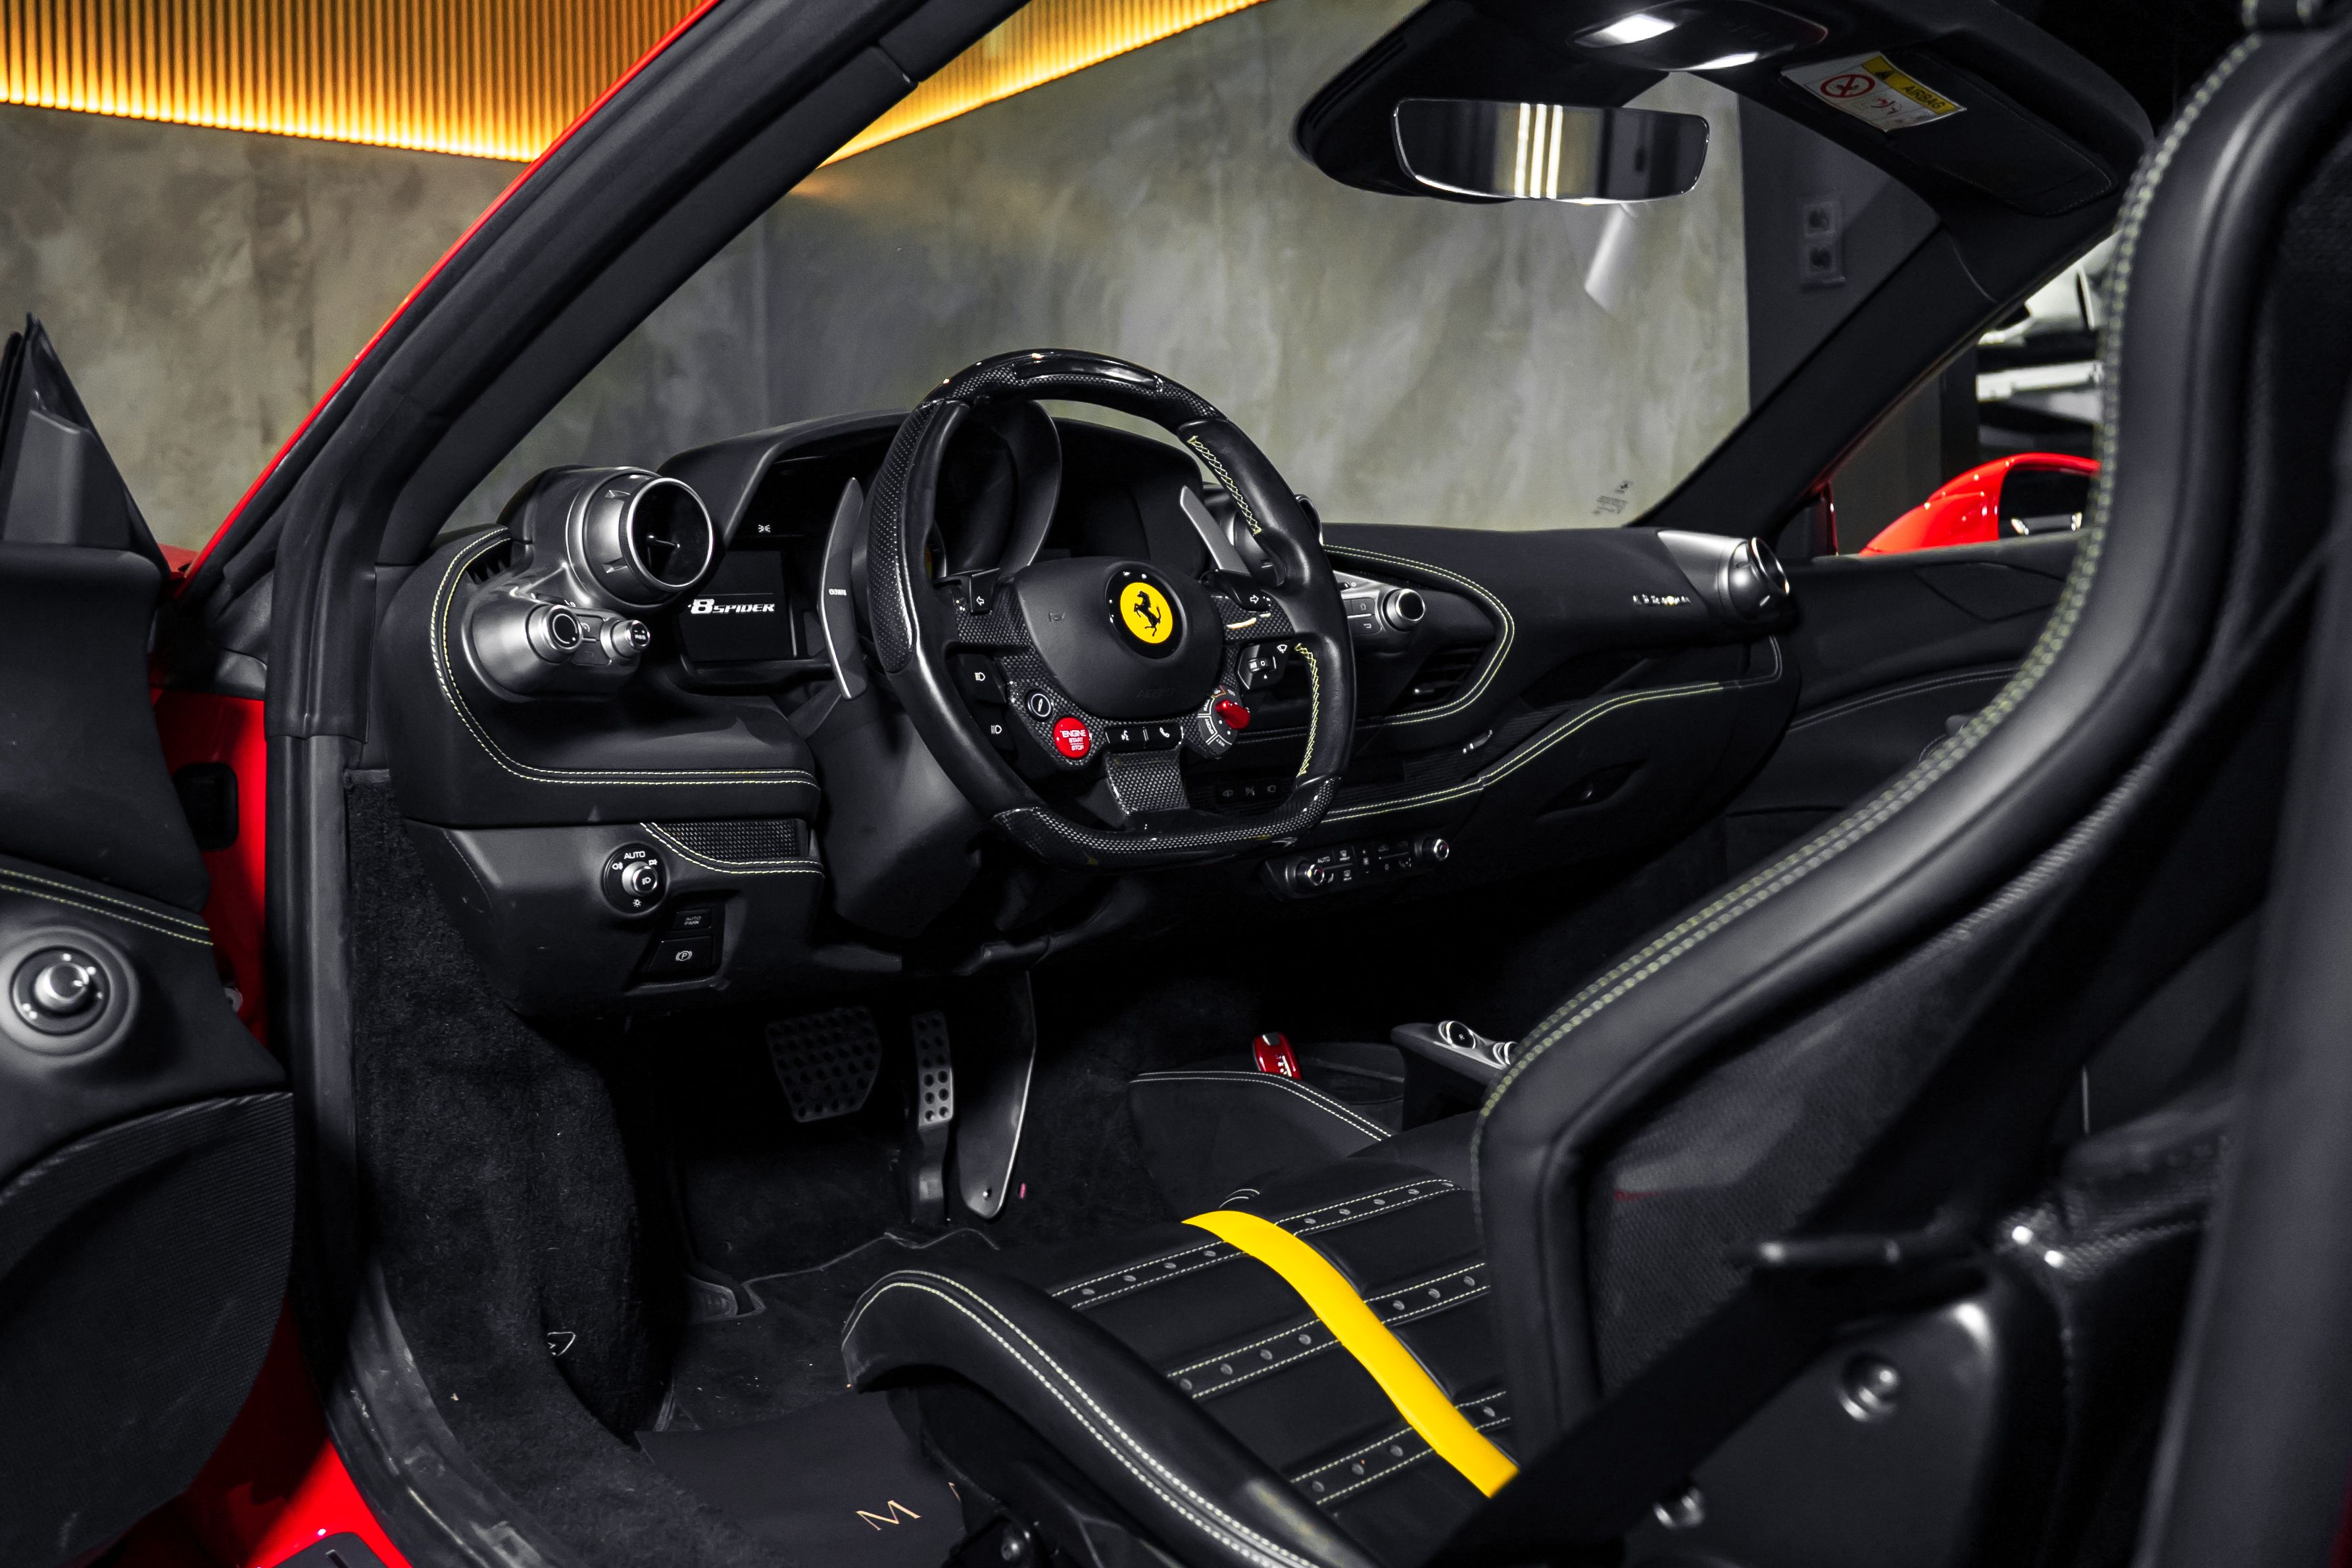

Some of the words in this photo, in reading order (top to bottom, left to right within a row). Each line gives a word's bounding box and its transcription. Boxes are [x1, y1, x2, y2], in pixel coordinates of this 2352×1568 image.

[1903, 85, 1946, 109] AIRBAG
[713, 603, 775, 613] SPIDER
[1062, 729, 1087, 738] ENGINE
[1215, 738, 1225, 747] WET
[624, 850, 646, 860] AUTO
